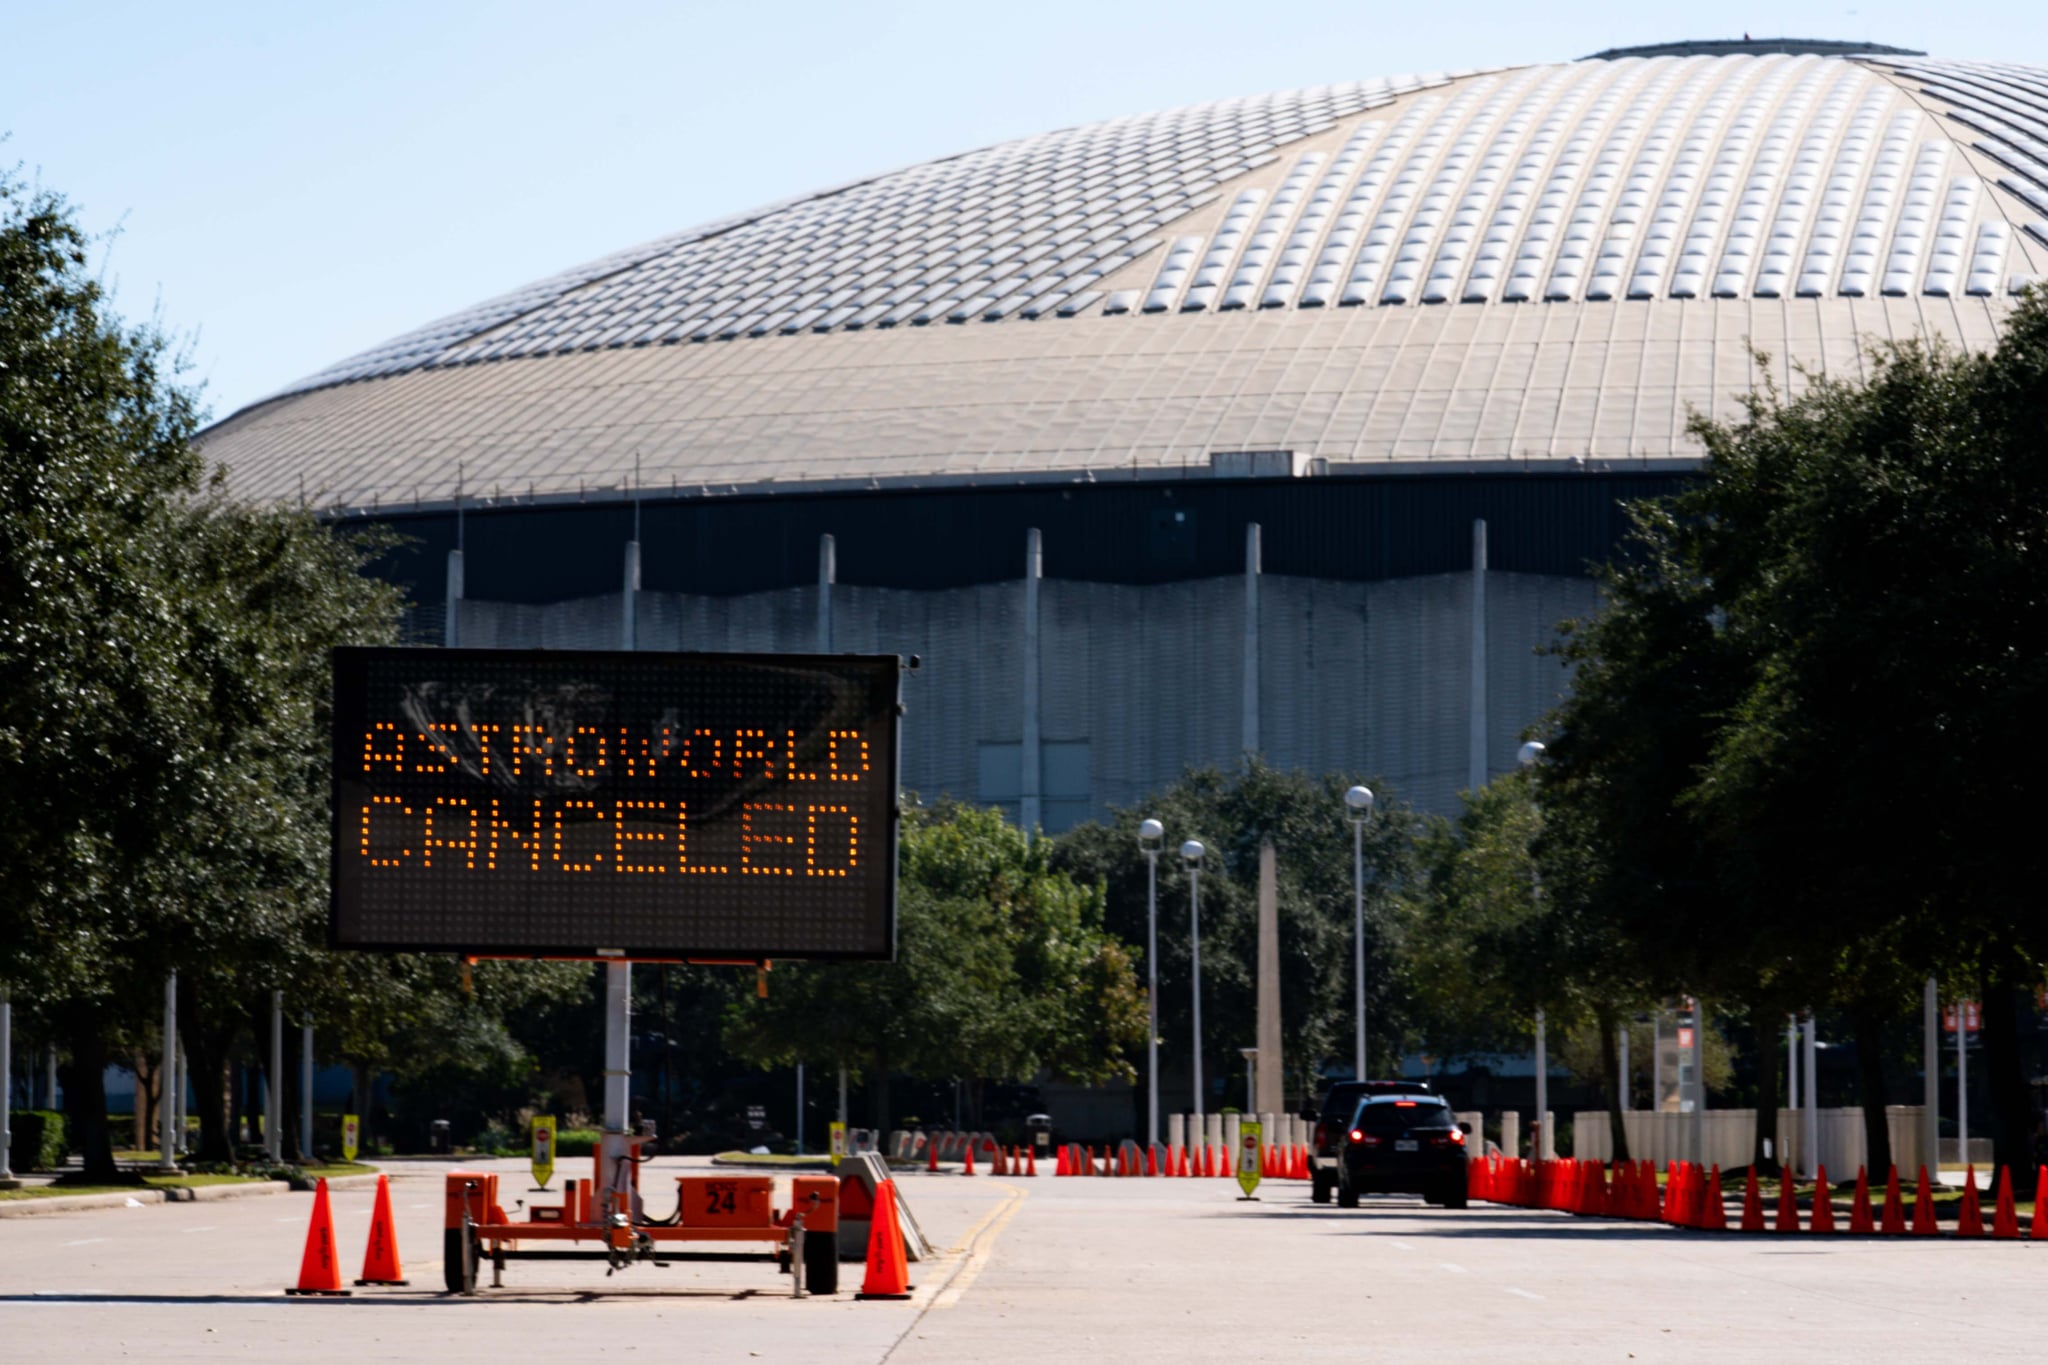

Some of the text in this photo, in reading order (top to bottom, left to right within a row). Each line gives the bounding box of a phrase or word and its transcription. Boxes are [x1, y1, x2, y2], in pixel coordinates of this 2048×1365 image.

[363, 722, 870, 782] ASTROWORLD
[361, 796, 858, 877] CANCELED
[706, 1191, 736, 1215] 24
